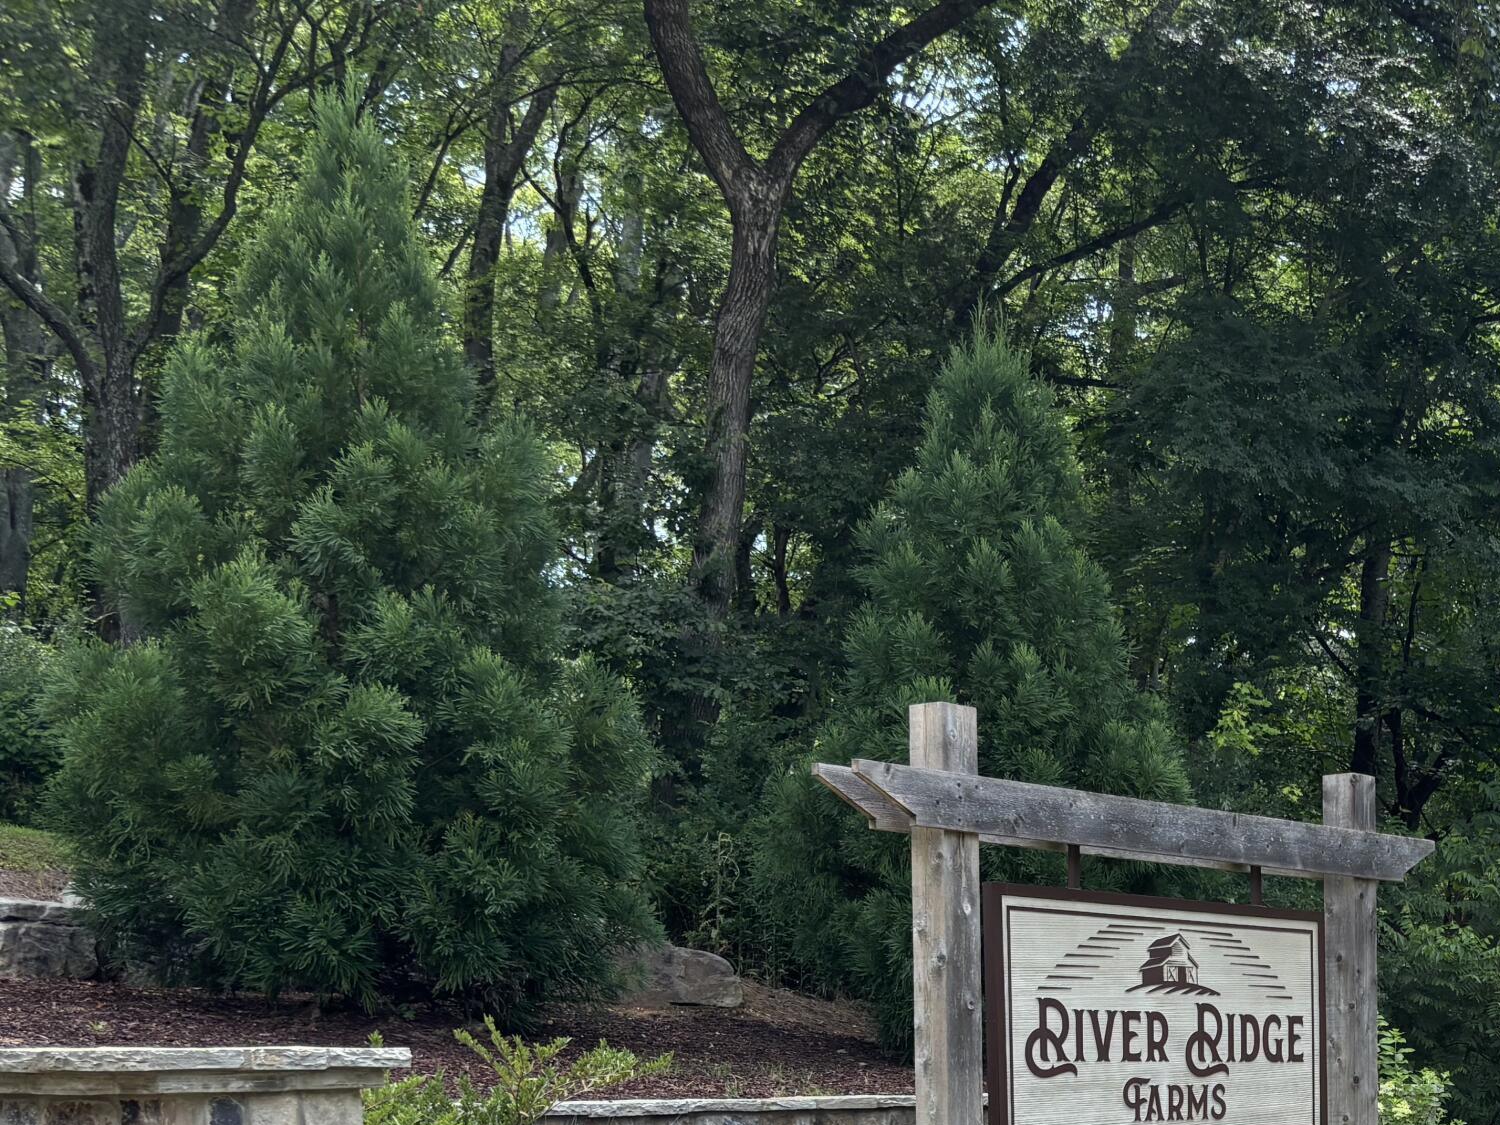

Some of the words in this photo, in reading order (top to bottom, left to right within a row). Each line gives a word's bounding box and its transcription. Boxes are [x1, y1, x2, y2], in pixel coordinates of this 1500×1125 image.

[1025, 997, 1169, 1077] RIVER
[1185, 1003, 1304, 1077] RIDGE
[1123, 1077, 1226, 1121] FARMS
